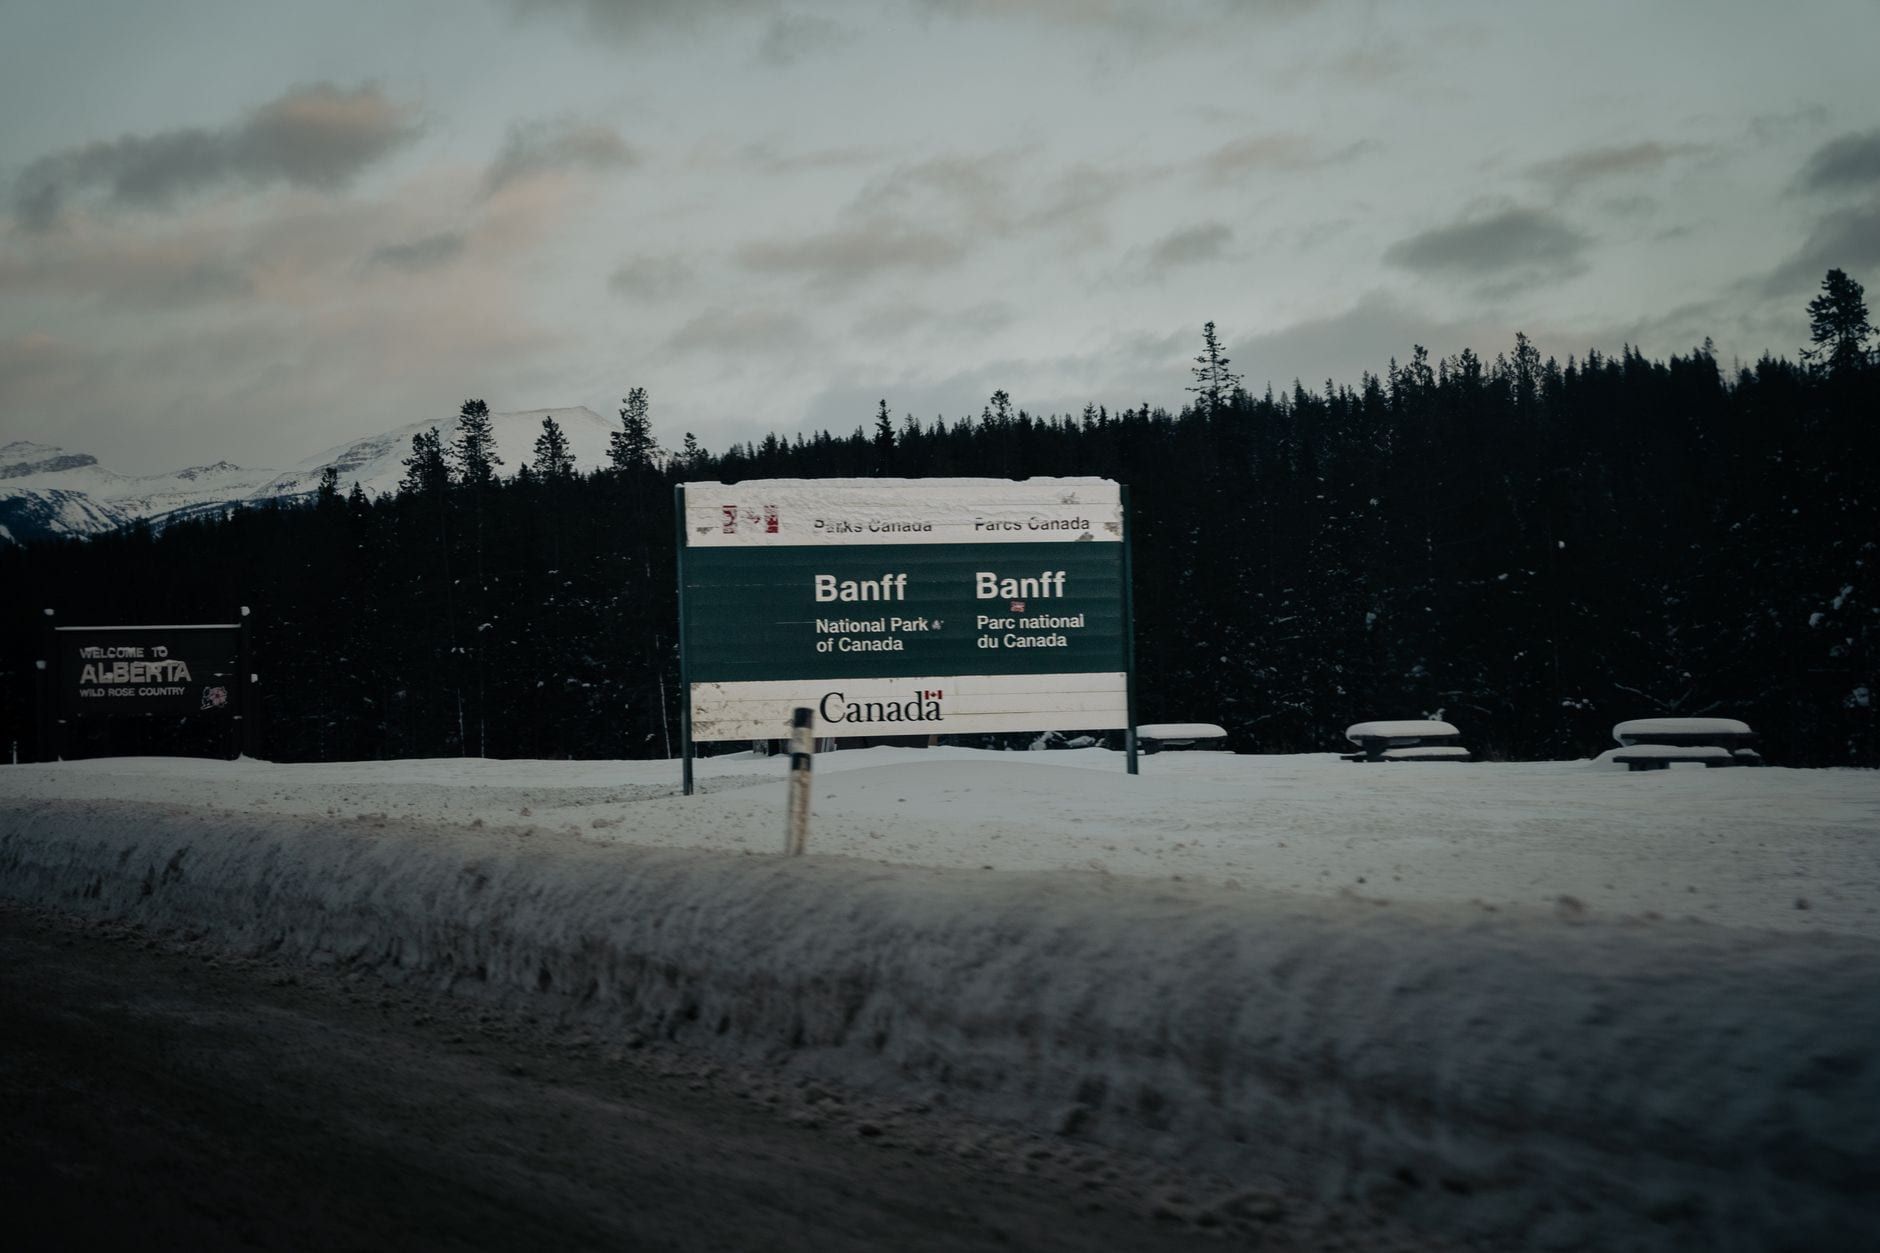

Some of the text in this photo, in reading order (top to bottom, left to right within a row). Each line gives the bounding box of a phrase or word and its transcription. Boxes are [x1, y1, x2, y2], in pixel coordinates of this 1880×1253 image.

[1028, 516, 1090, 530] Canada
[815, 573, 908, 602] Banff
[976, 571, 1067, 599] Banff
[816, 617, 929, 634] National Park
[976, 613, 1085, 630] Parc national
[816, 636, 904, 652] of Canada
[977, 633, 1068, 649] du Canada
[79, 646, 168, 659] WELCOME TO
[79, 659, 192, 684] ALBERTA
[79, 687, 186, 697] WILD ROSE COUNTRY
[819, 690, 944, 724] Canada
